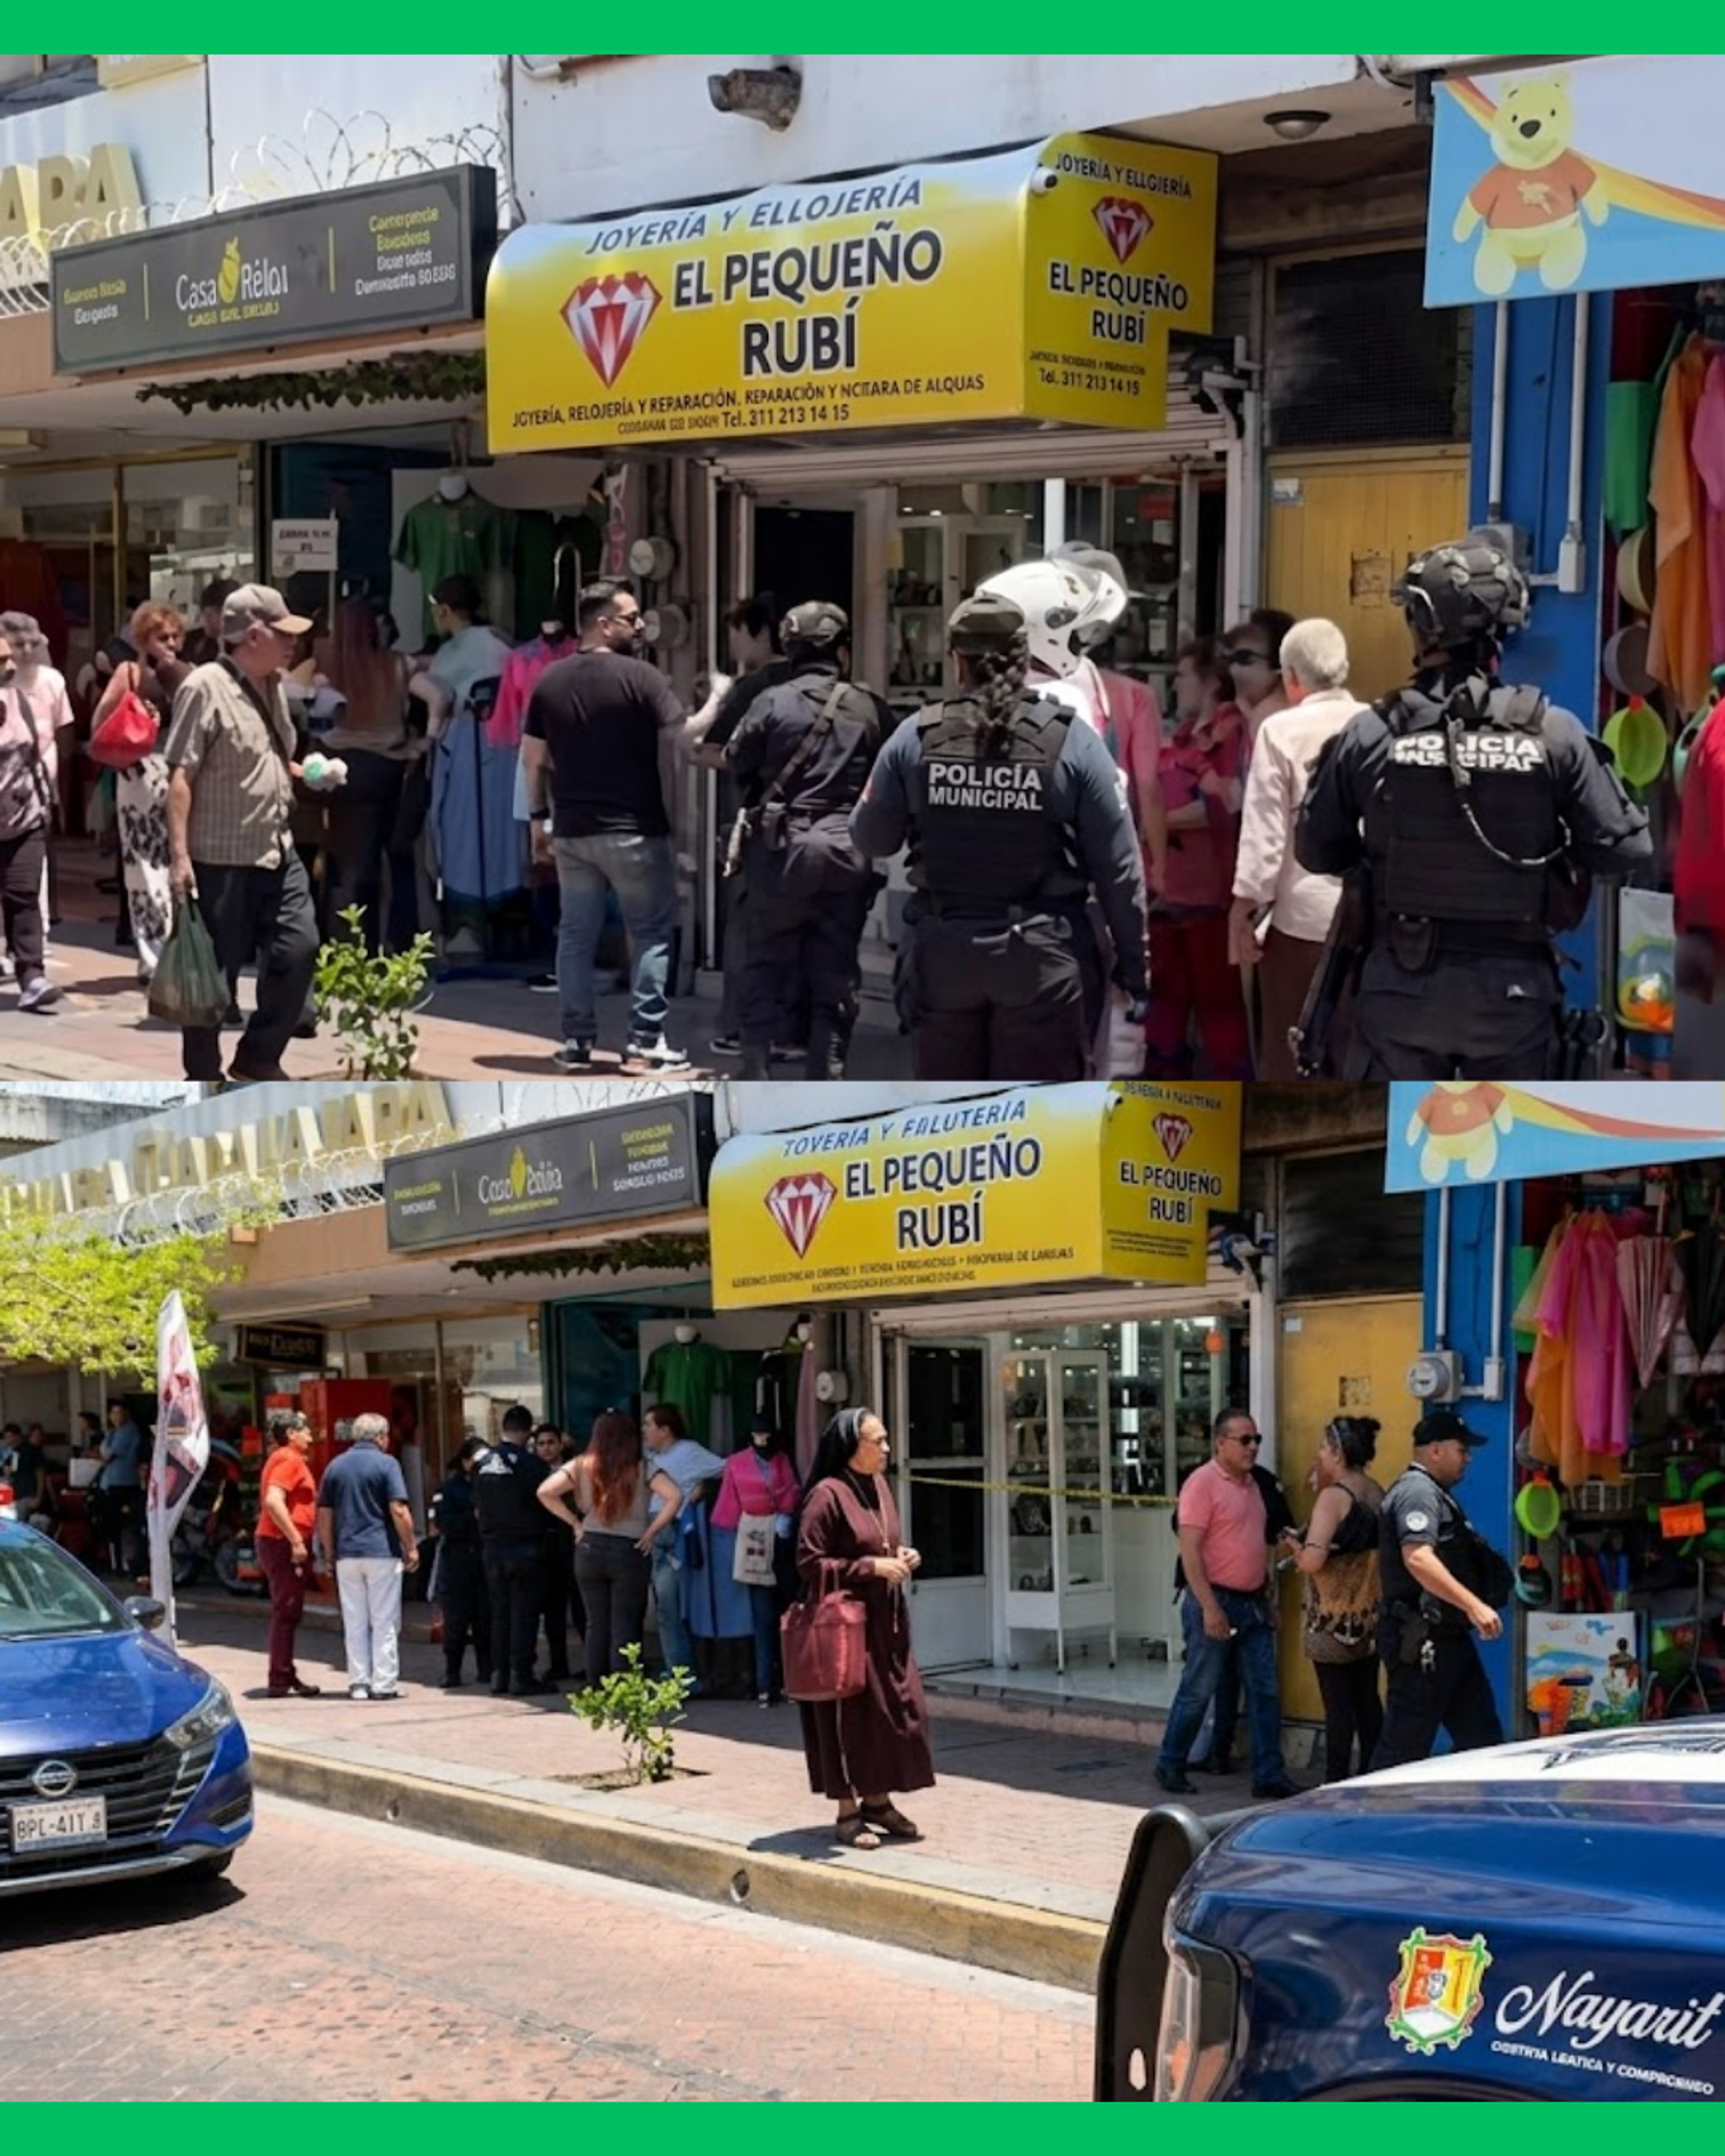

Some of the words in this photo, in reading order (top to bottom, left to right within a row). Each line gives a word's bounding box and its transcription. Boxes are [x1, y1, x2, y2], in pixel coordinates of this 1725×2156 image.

[584, 211, 707, 255] JOYERÍA
[722, 205, 743, 231] Y
[750, 175, 921, 227] ELLOJERÍA
[176, 274, 217, 311] Casa
[675, 260, 713, 307] EL
[724, 221, 942, 305] PEQUEÑO
[1051, 261, 1074, 292] EL
[1081, 267, 1188, 311] PEQUEÑO
[743, 296, 859, 376] RUBÍ
[929, 787, 1042, 810] MUNICIPAL
[846, 1162, 876, 1198] EL
[884, 1133, 1040, 1193] PEQUEÑO
[1121, 1161, 1139, 1184] EL
[898, 1190, 982, 1249] RUBÍ
[1495, 1970, 1725, 2049] Nayarit
